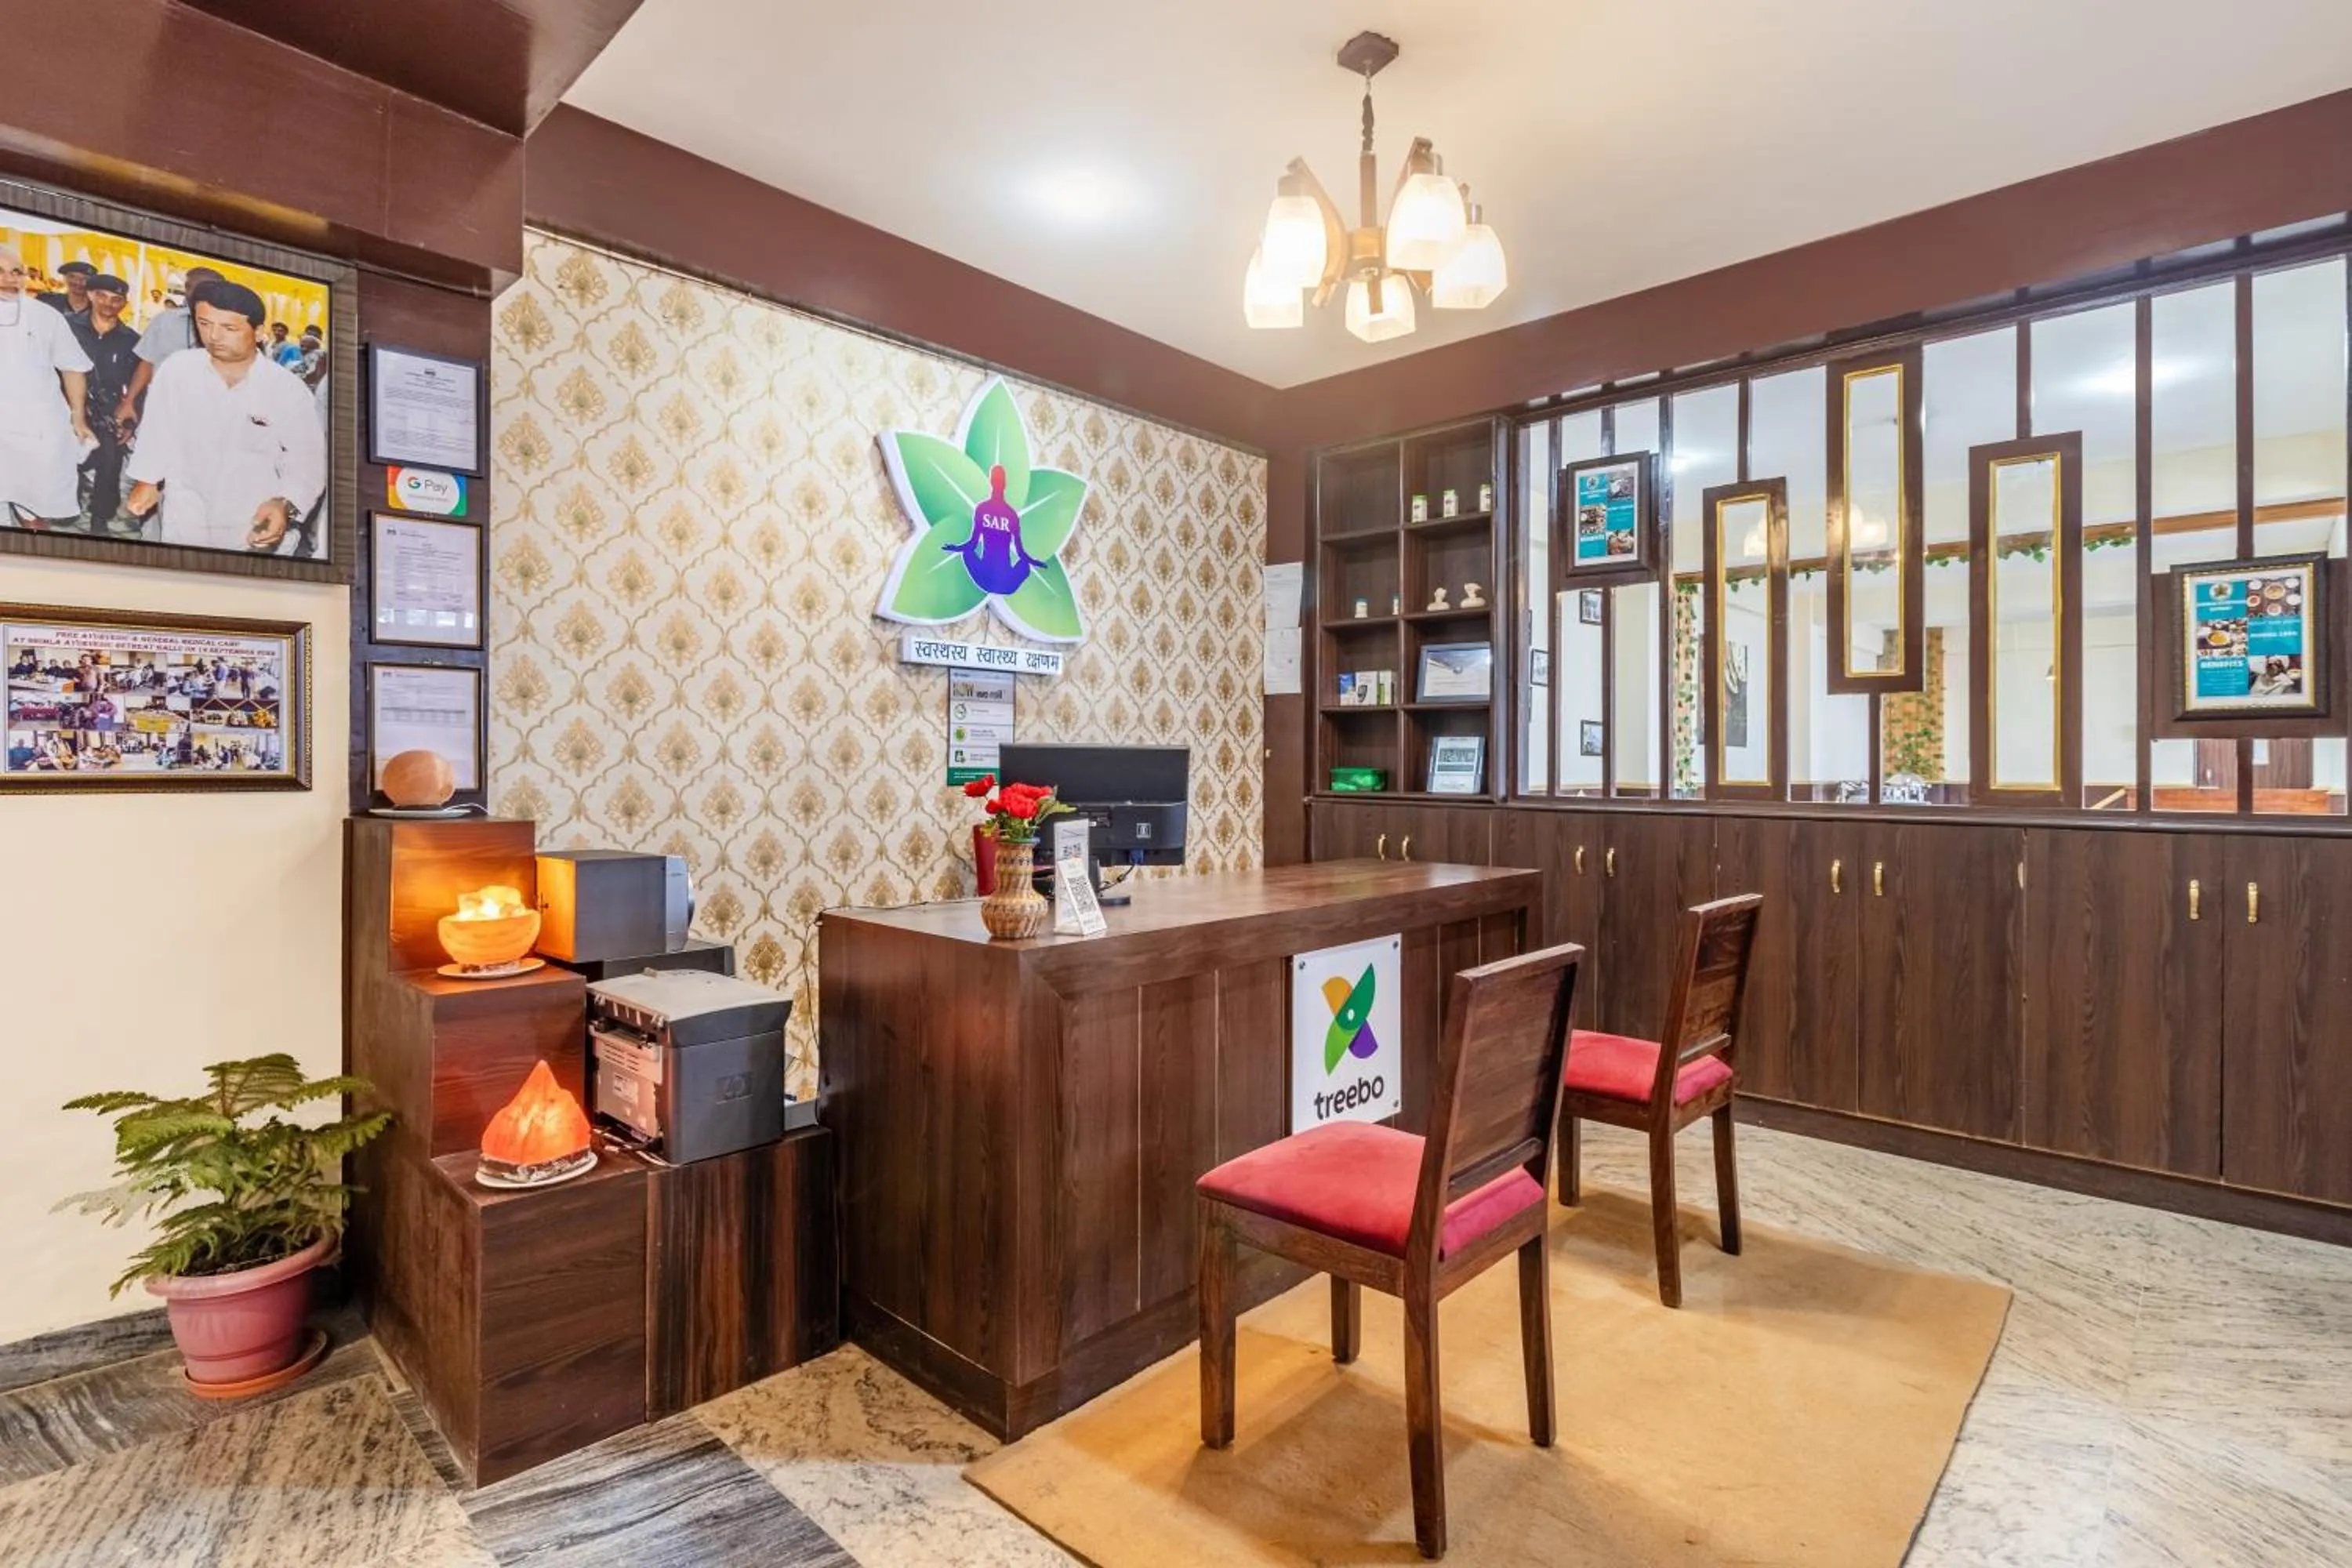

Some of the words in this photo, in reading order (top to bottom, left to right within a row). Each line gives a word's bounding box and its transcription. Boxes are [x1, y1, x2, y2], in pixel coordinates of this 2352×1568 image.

[407, 476, 421, 489] G
[424, 478, 448, 495] Pay
[982, 514, 1011, 532] SAR
[1313, 1075, 1384, 1120] treebo
